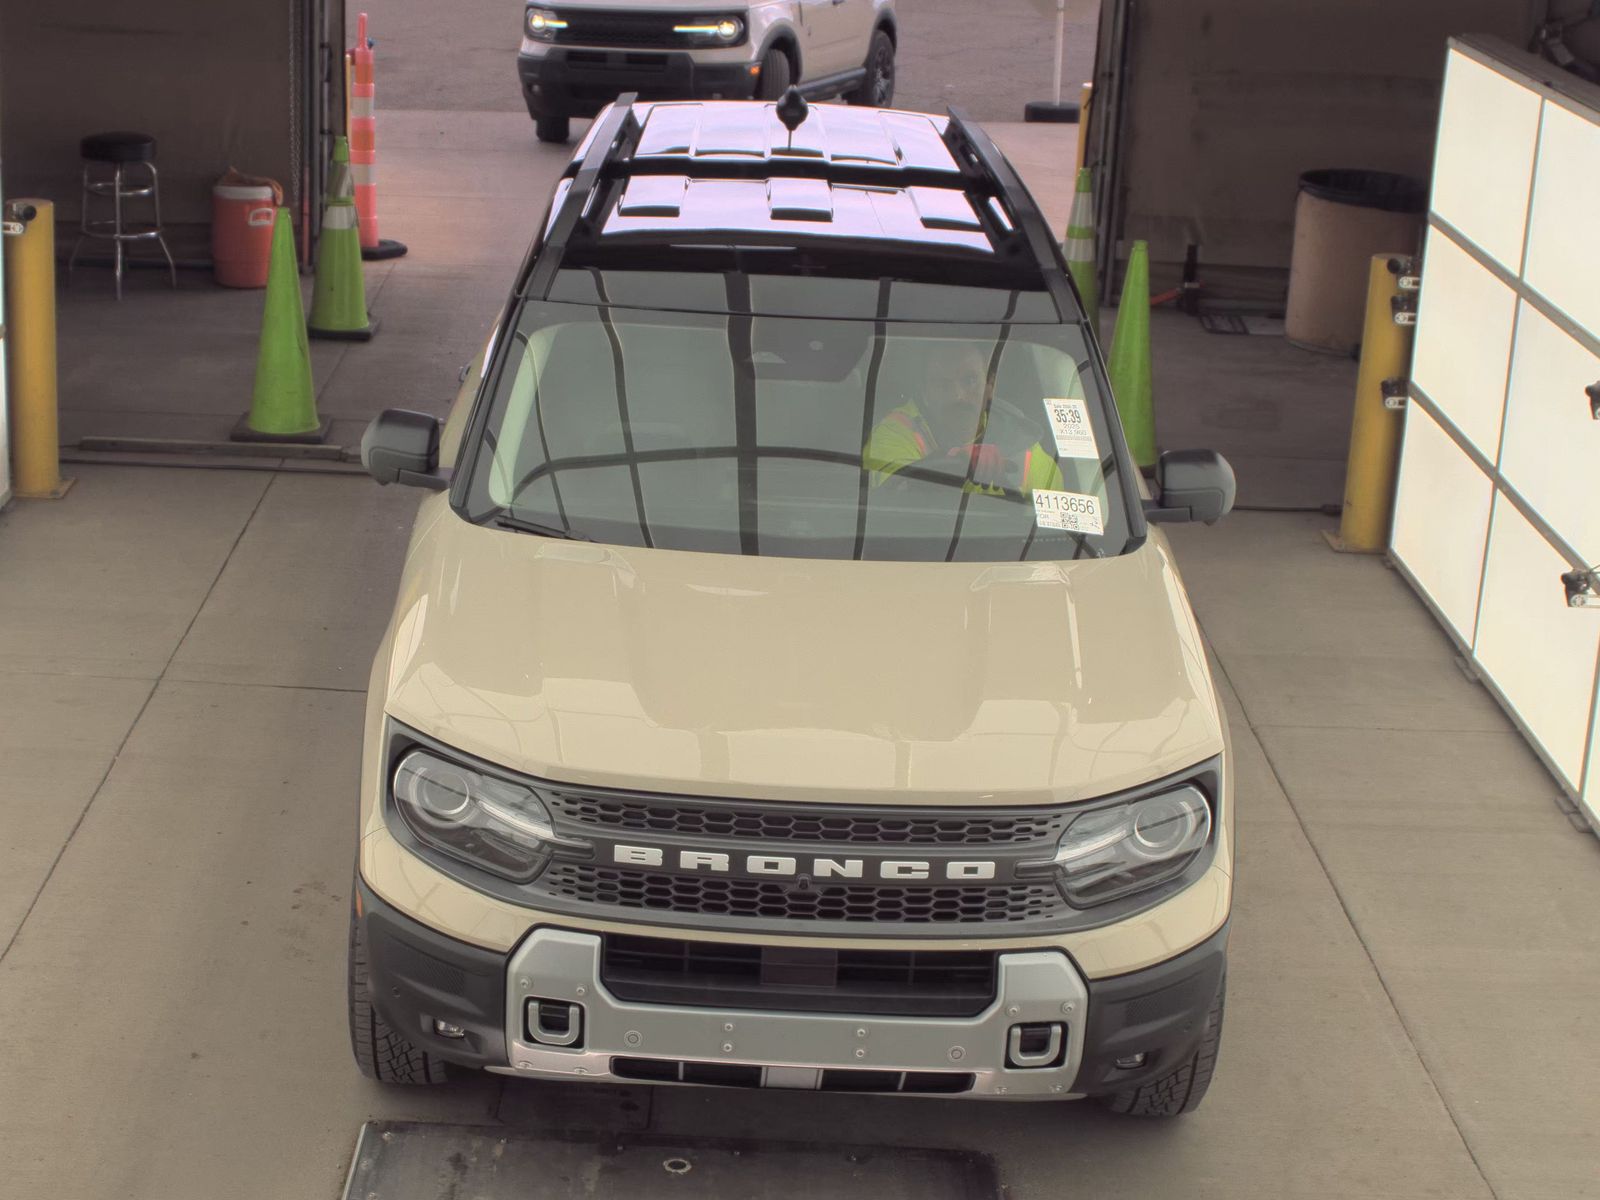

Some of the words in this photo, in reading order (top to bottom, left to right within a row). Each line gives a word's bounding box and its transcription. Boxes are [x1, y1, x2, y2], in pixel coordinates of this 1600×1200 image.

[1054, 409, 1081, 423] 35:39
[1036, 494, 1095, 515] 4113656
[613, 844, 996, 880] BRONCO
